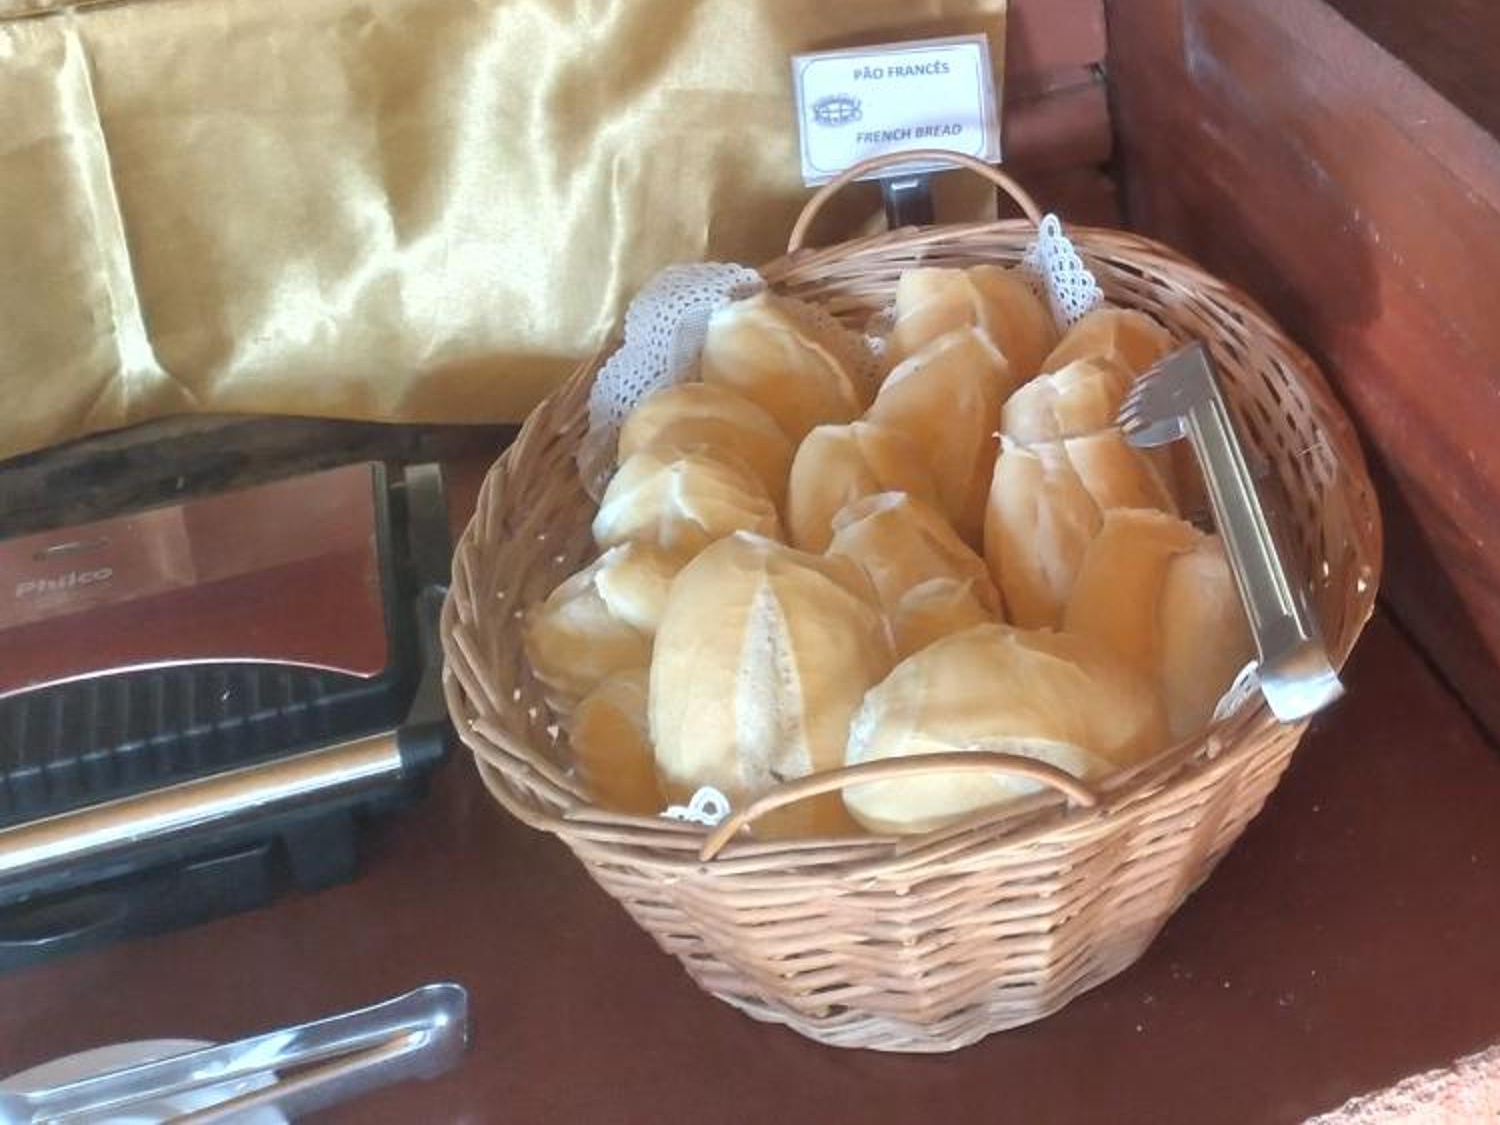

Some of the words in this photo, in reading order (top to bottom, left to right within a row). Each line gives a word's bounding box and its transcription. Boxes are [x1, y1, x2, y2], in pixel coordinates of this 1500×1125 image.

[853, 66, 885, 80] PÃO
[856, 130, 911, 144] FRENCH
[915, 123, 963, 138] BREAD
[15, 568, 113, 598] Philco
